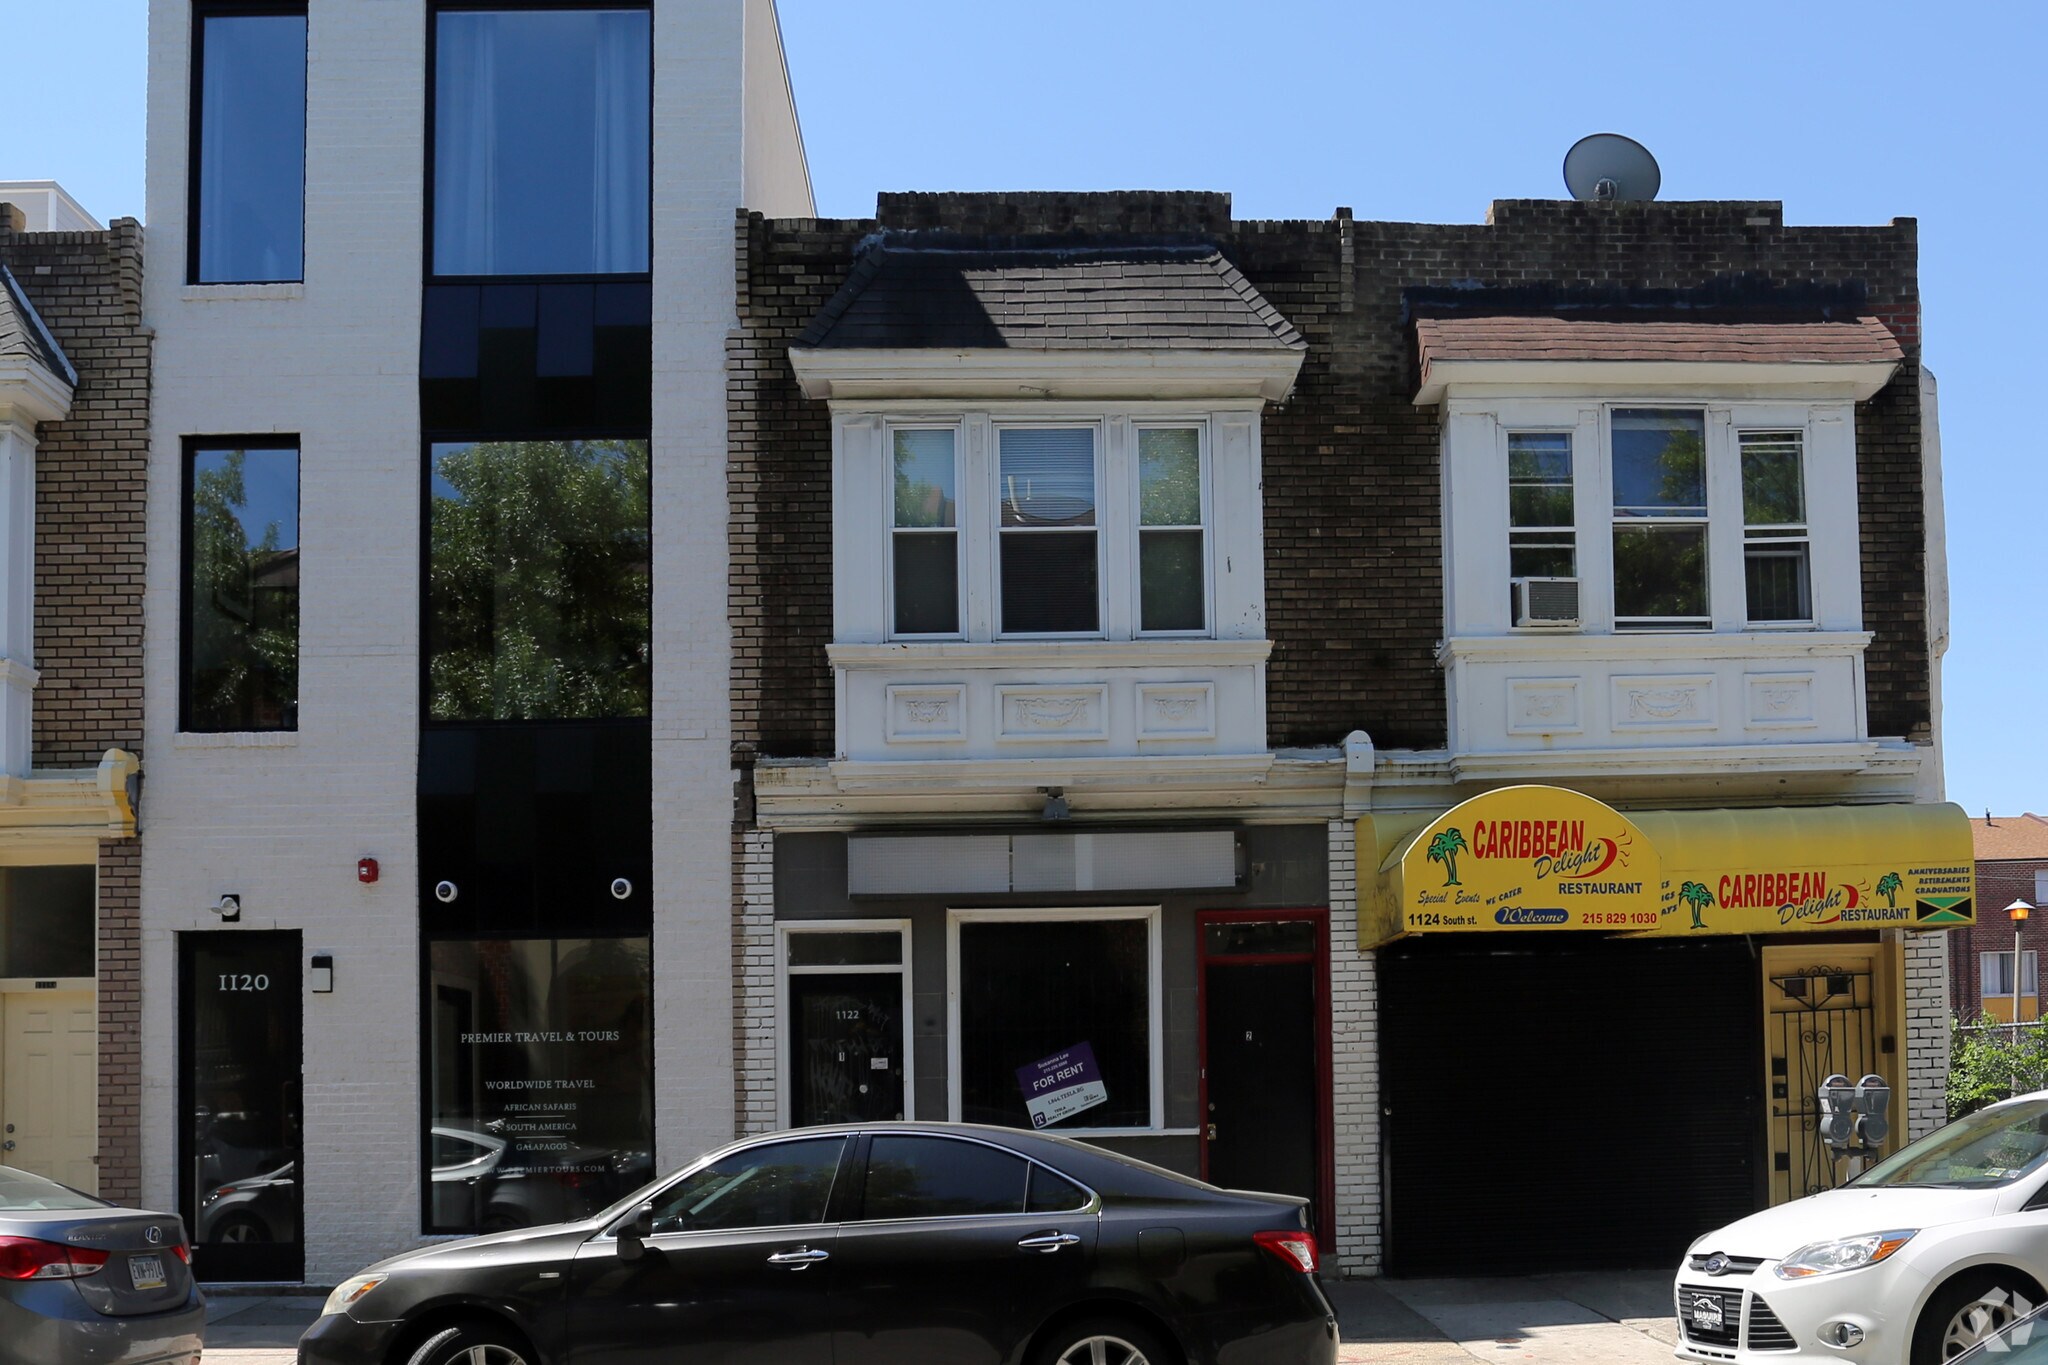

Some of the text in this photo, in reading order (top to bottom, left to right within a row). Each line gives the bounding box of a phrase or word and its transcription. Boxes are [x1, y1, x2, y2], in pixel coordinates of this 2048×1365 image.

[1473, 820, 1584, 859] CARIBBEAN
[1534, 841, 1600, 880] Delight
[1908, 867, 1970, 875] ANNIVERSARIES
[1498, 887, 1522, 902] CATER
[1558, 883, 1642, 894] RESTAURANT
[1718, 871, 1826, 909] CARIBBEAN
[1418, 890, 1480, 906] Special Events
[1777, 889, 1841, 925] Delight
[1408, 913, 1477, 926] 1124 South st.
[1501, 907, 1564, 923] Welcome
[1582, 912, 1657, 924] 215 829 1030
[1840, 908, 1910, 922] RESTAURANT
[219, 973, 270, 991] 1120
[836, 1010, 860, 1019] 1122
[461, 1031, 620, 1043] PREMIER TRAVEL & TOURS
[1033, 1075, 1056, 1091] FOR
[1056, 1062, 1084, 1082] RENT
[485, 1080, 595, 1090] WORLDWIDE TRAVEL
[504, 1103, 577, 1112] AFRICAN SAFARIS
[506, 1123, 577, 1131] SOUTH AMERICA
[516, 1142, 568, 1151] GALAPAGOS
